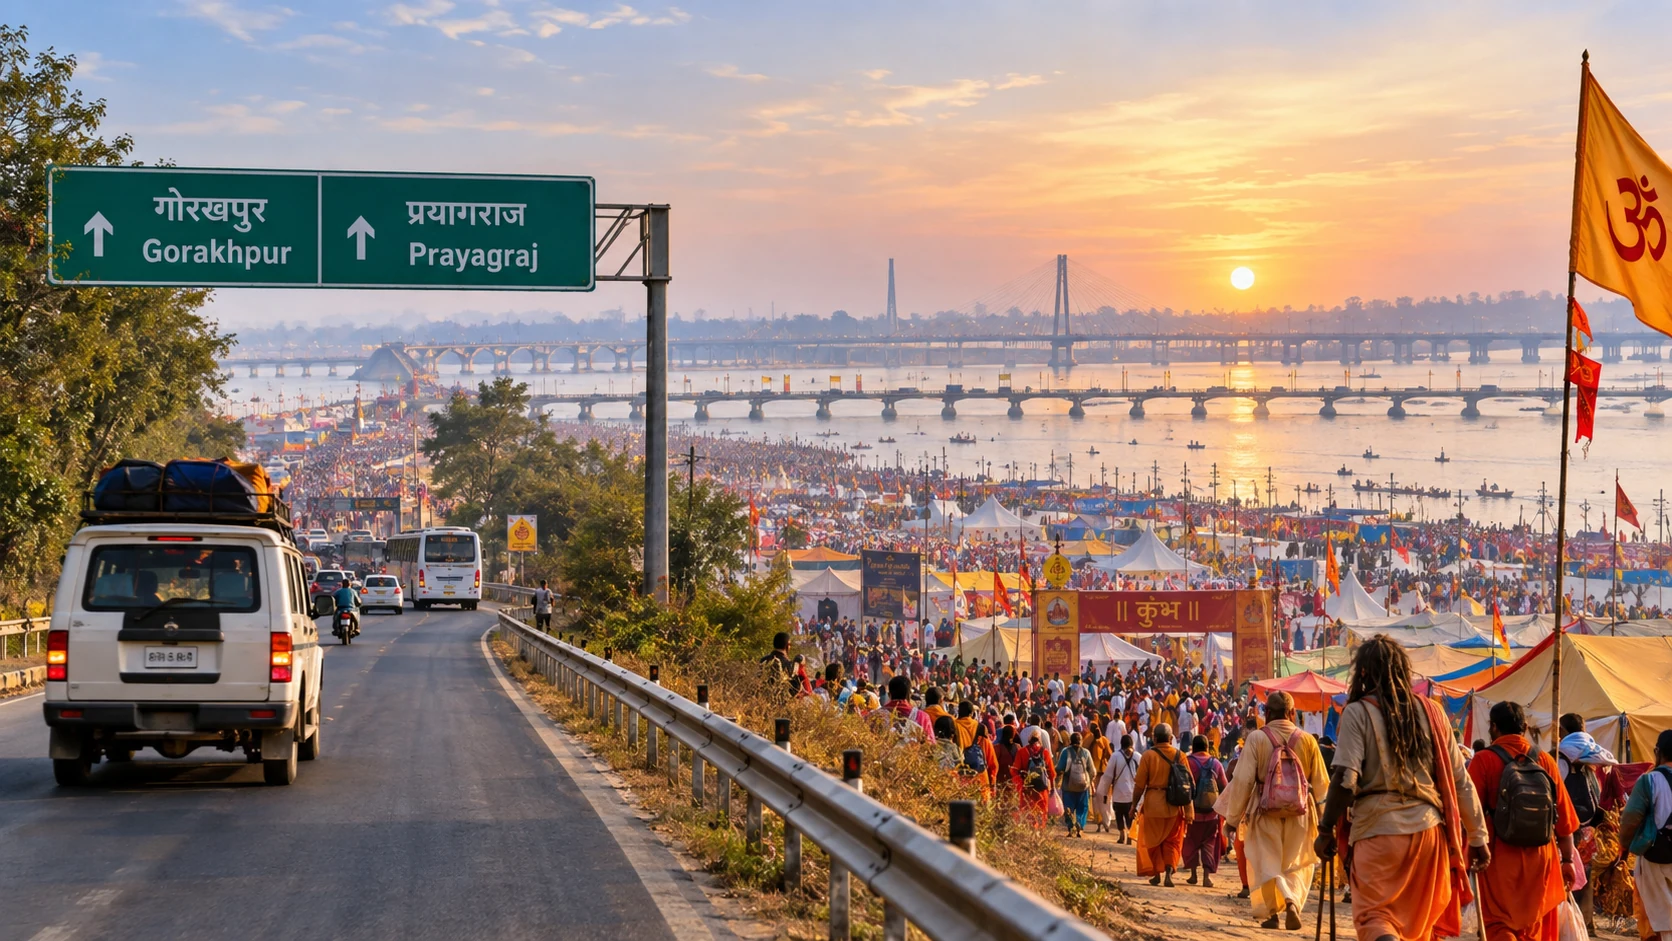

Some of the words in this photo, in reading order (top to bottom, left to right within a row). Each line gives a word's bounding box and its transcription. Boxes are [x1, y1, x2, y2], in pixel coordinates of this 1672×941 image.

[153, 188, 268, 232] गोरखपुर
[405, 201, 527, 227] प्रयागराज
[142, 238, 292, 270] Gorakhpur
[409, 242, 538, 273] Prayagraj
[1135, 596, 1182, 628] कुंभ
